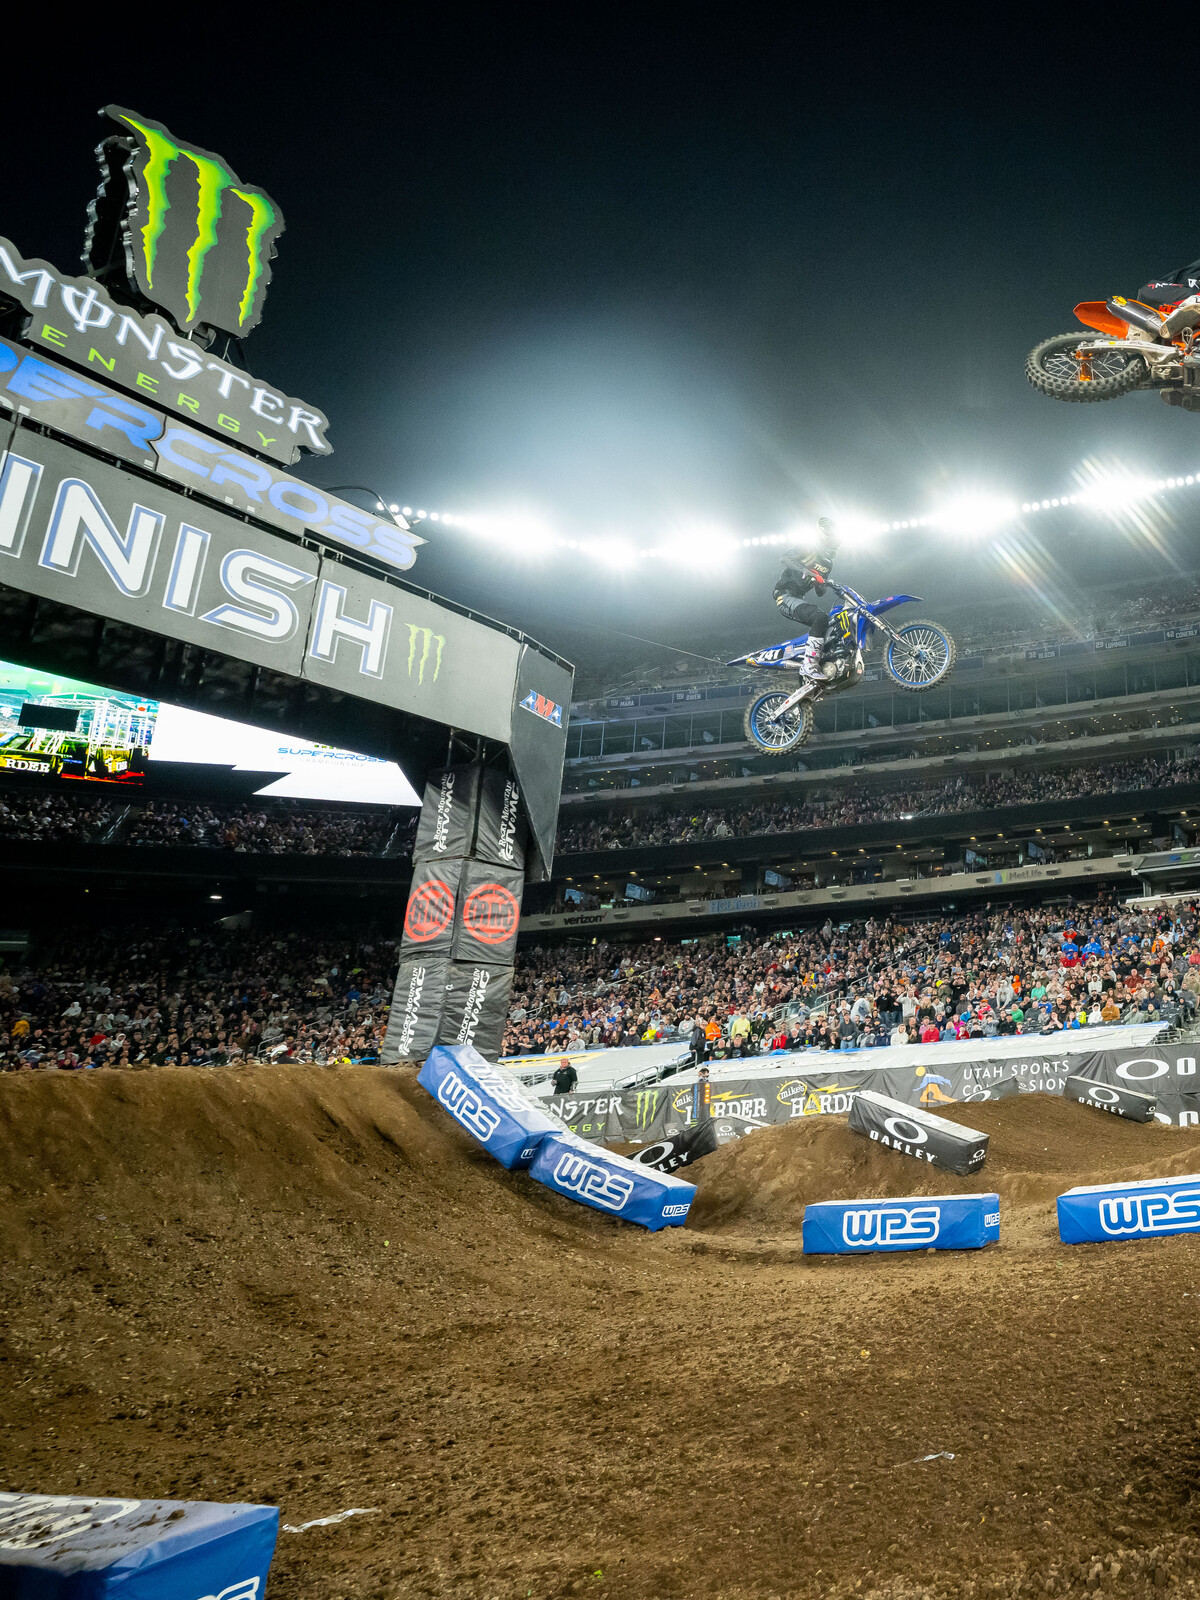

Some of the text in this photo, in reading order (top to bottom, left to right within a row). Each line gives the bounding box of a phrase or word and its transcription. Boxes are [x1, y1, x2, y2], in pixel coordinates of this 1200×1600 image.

[0, 243, 328, 450] MONSTER
[40, 323, 277, 448] ENERGY
[1175, 629, 1198, 639] CONERLY
[519, 689, 563, 728] AMA
[278, 747, 388, 763] SUPERCROSS
[433, 773, 448, 840] ROCKY MOUNTAIN
[498, 780, 513, 847] ROCKY MOUNTAIN
[1009, 868, 1042, 880] MetLife
[563, 913, 602, 925] verizon
[400, 967, 419, 1042] ROCKY MOUNTAIN
[457, 968, 481, 1042] ROCKY MOUNTAIN
[963, 1060, 1070, 1080] UTAH SPORTS
[962, 1079, 1067, 1097] COSION
[437, 1071, 501, 1142] WPS
[550, 1095, 624, 1121] NSTER
[1078, 1096, 1126, 1115] OAKLEY
[568, 1122, 606, 1133] RGY
[869, 1130, 936, 1163] OAKLEY
[651, 1152, 689, 1173] LEY
[553, 1152, 635, 1211] WPS
[662, 1203, 690, 1217] WPS
[842, 1206, 941, 1246] WPS
